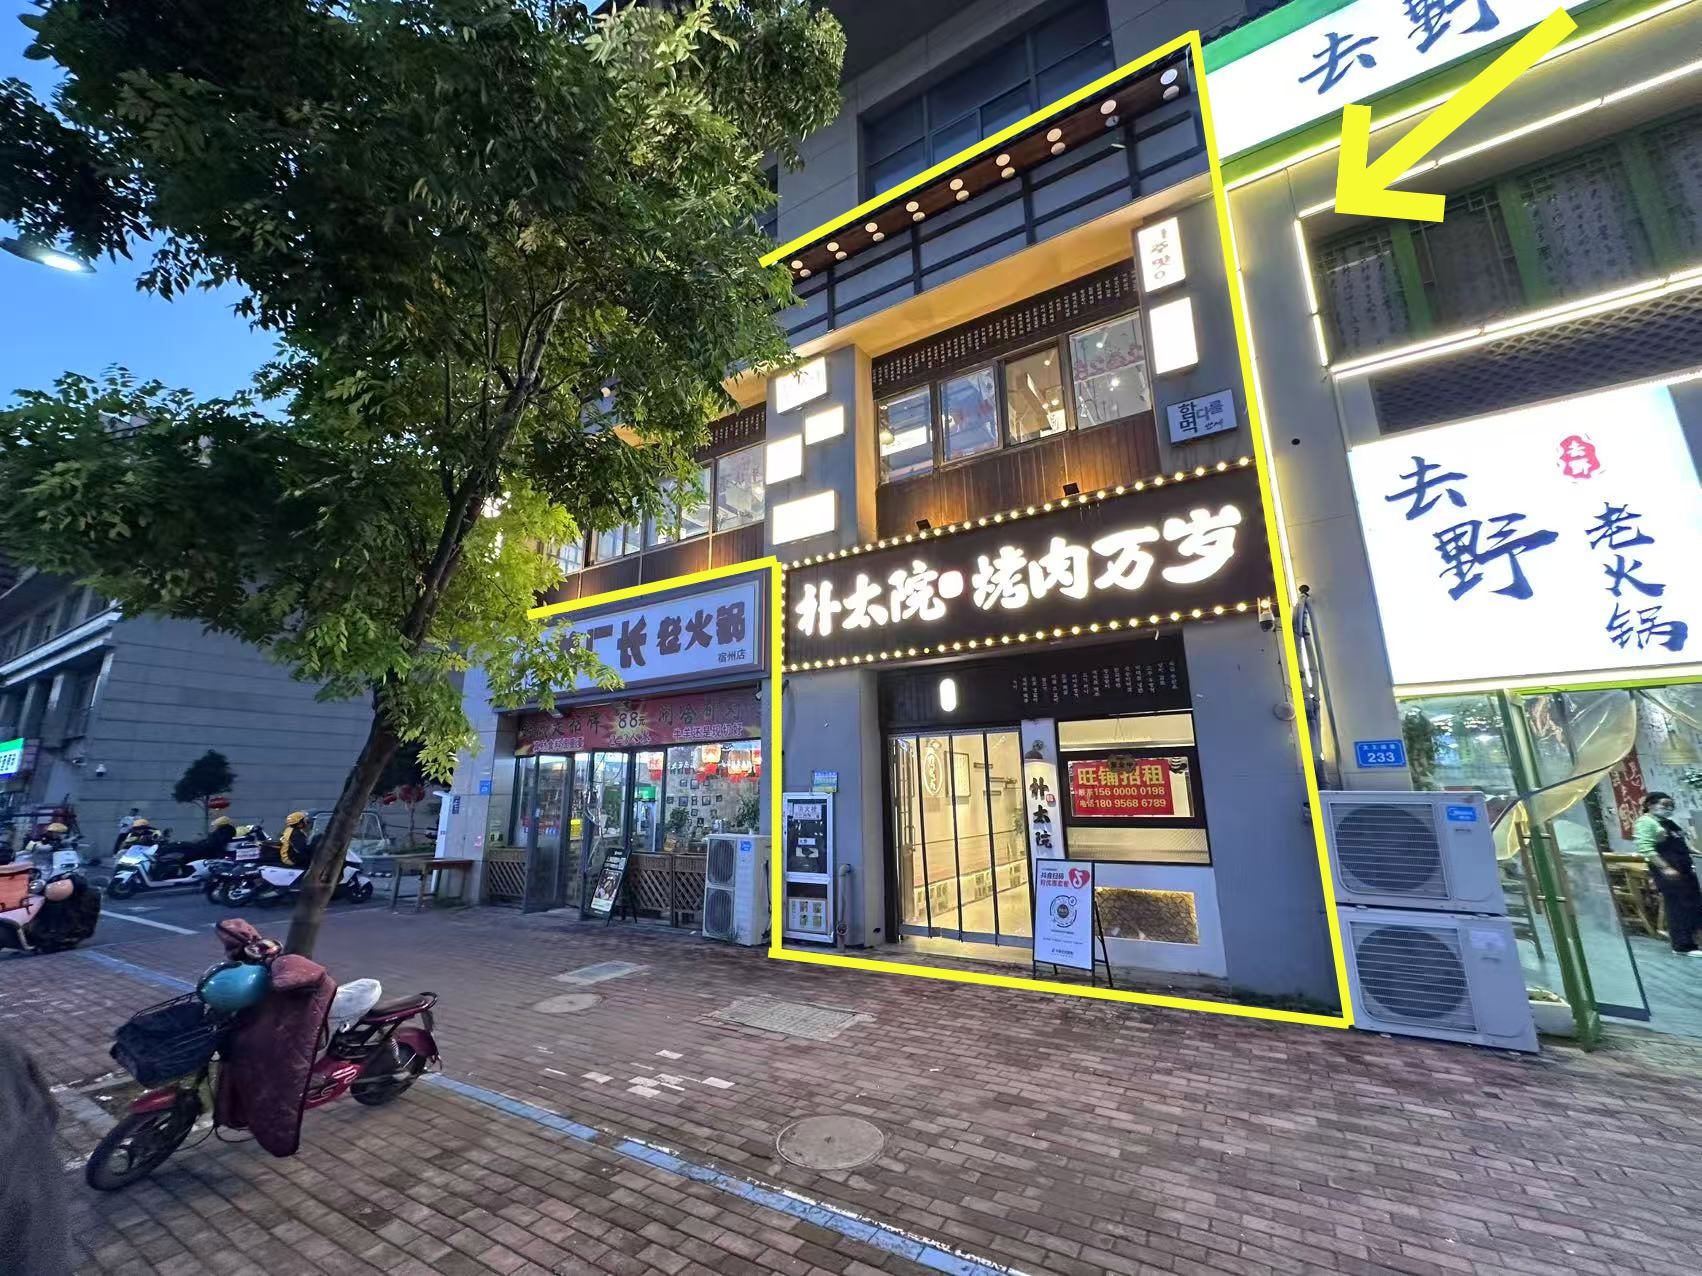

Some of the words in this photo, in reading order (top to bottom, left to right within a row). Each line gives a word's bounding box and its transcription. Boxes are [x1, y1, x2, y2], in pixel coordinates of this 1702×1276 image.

[972, 504, 1242, 610] 烤肉万岁
[1584, 502, 1689, 652] 老火锅
[718, 649, 746, 663] 宿州店
[1367, 752, 1395, 763] 233
[1077, 765, 1165, 786] 旺铺招租
[1113, 788, 1138, 796] 0000
[1140, 787, 1165, 796] 0198
[1114, 799, 1139, 808] 9568
[1141, 799, 1166, 808] 6789
